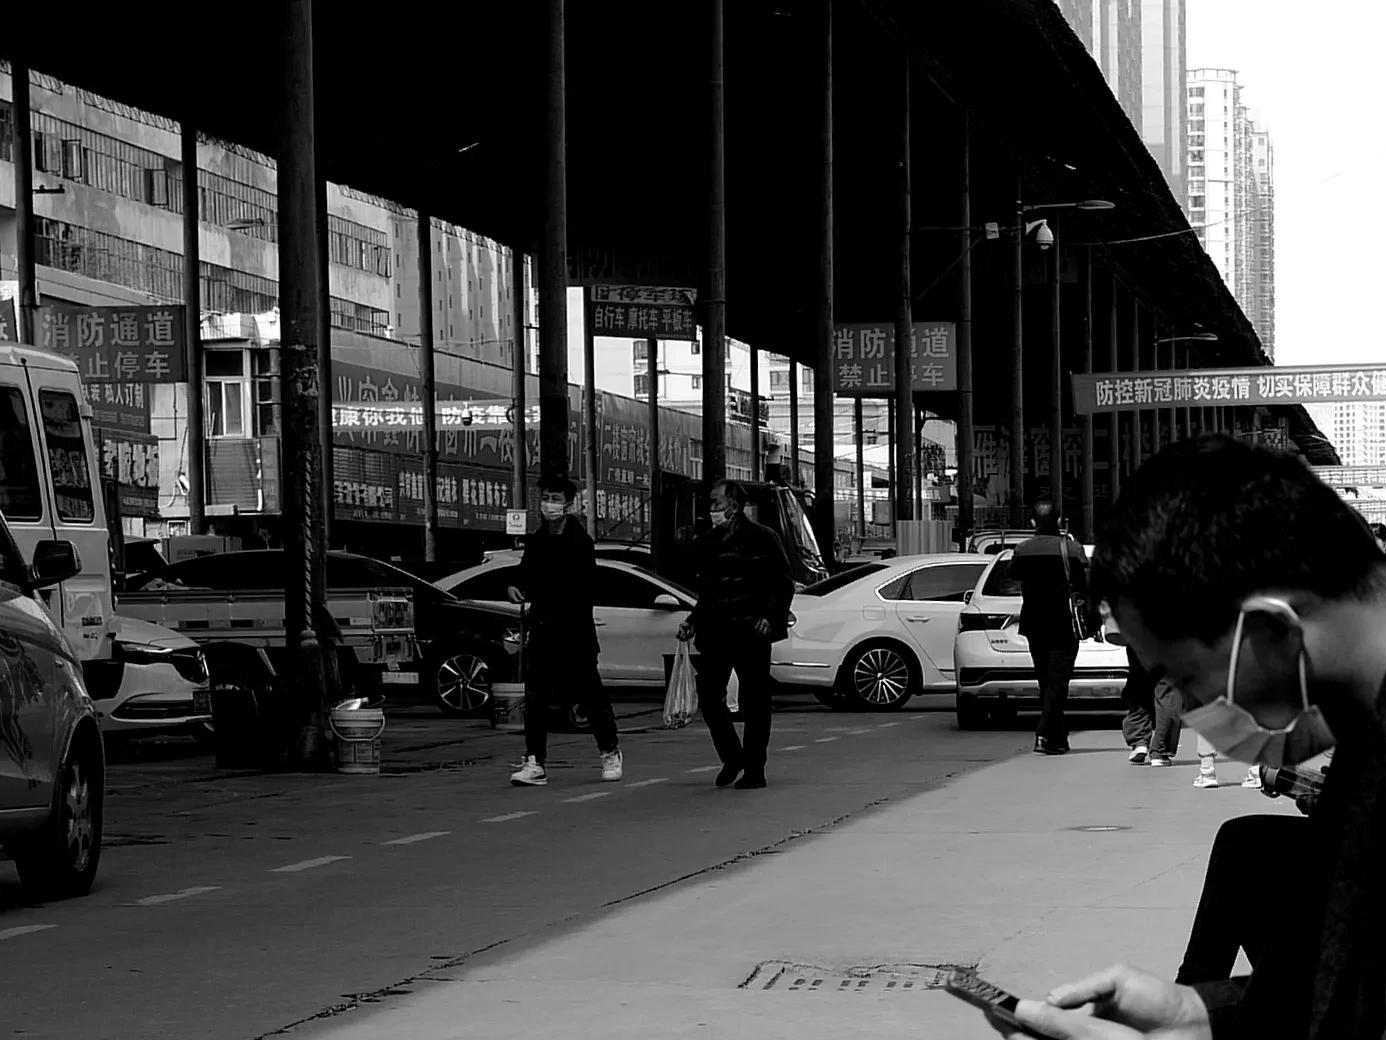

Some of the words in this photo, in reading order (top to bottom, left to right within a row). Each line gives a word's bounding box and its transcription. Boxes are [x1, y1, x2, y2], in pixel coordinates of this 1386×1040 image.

[43, 312, 175, 347] 消防通道
[833, 328, 949, 359] 消防道
[70, 351, 170, 379] 止停车
[839, 363, 944, 387] 禁止车
[1096, 376, 1250, 406] 防控新冠肺炎疫情
[332, 405, 424, 427] 康你我他
[442, 405, 540, 427] 防疫靠
